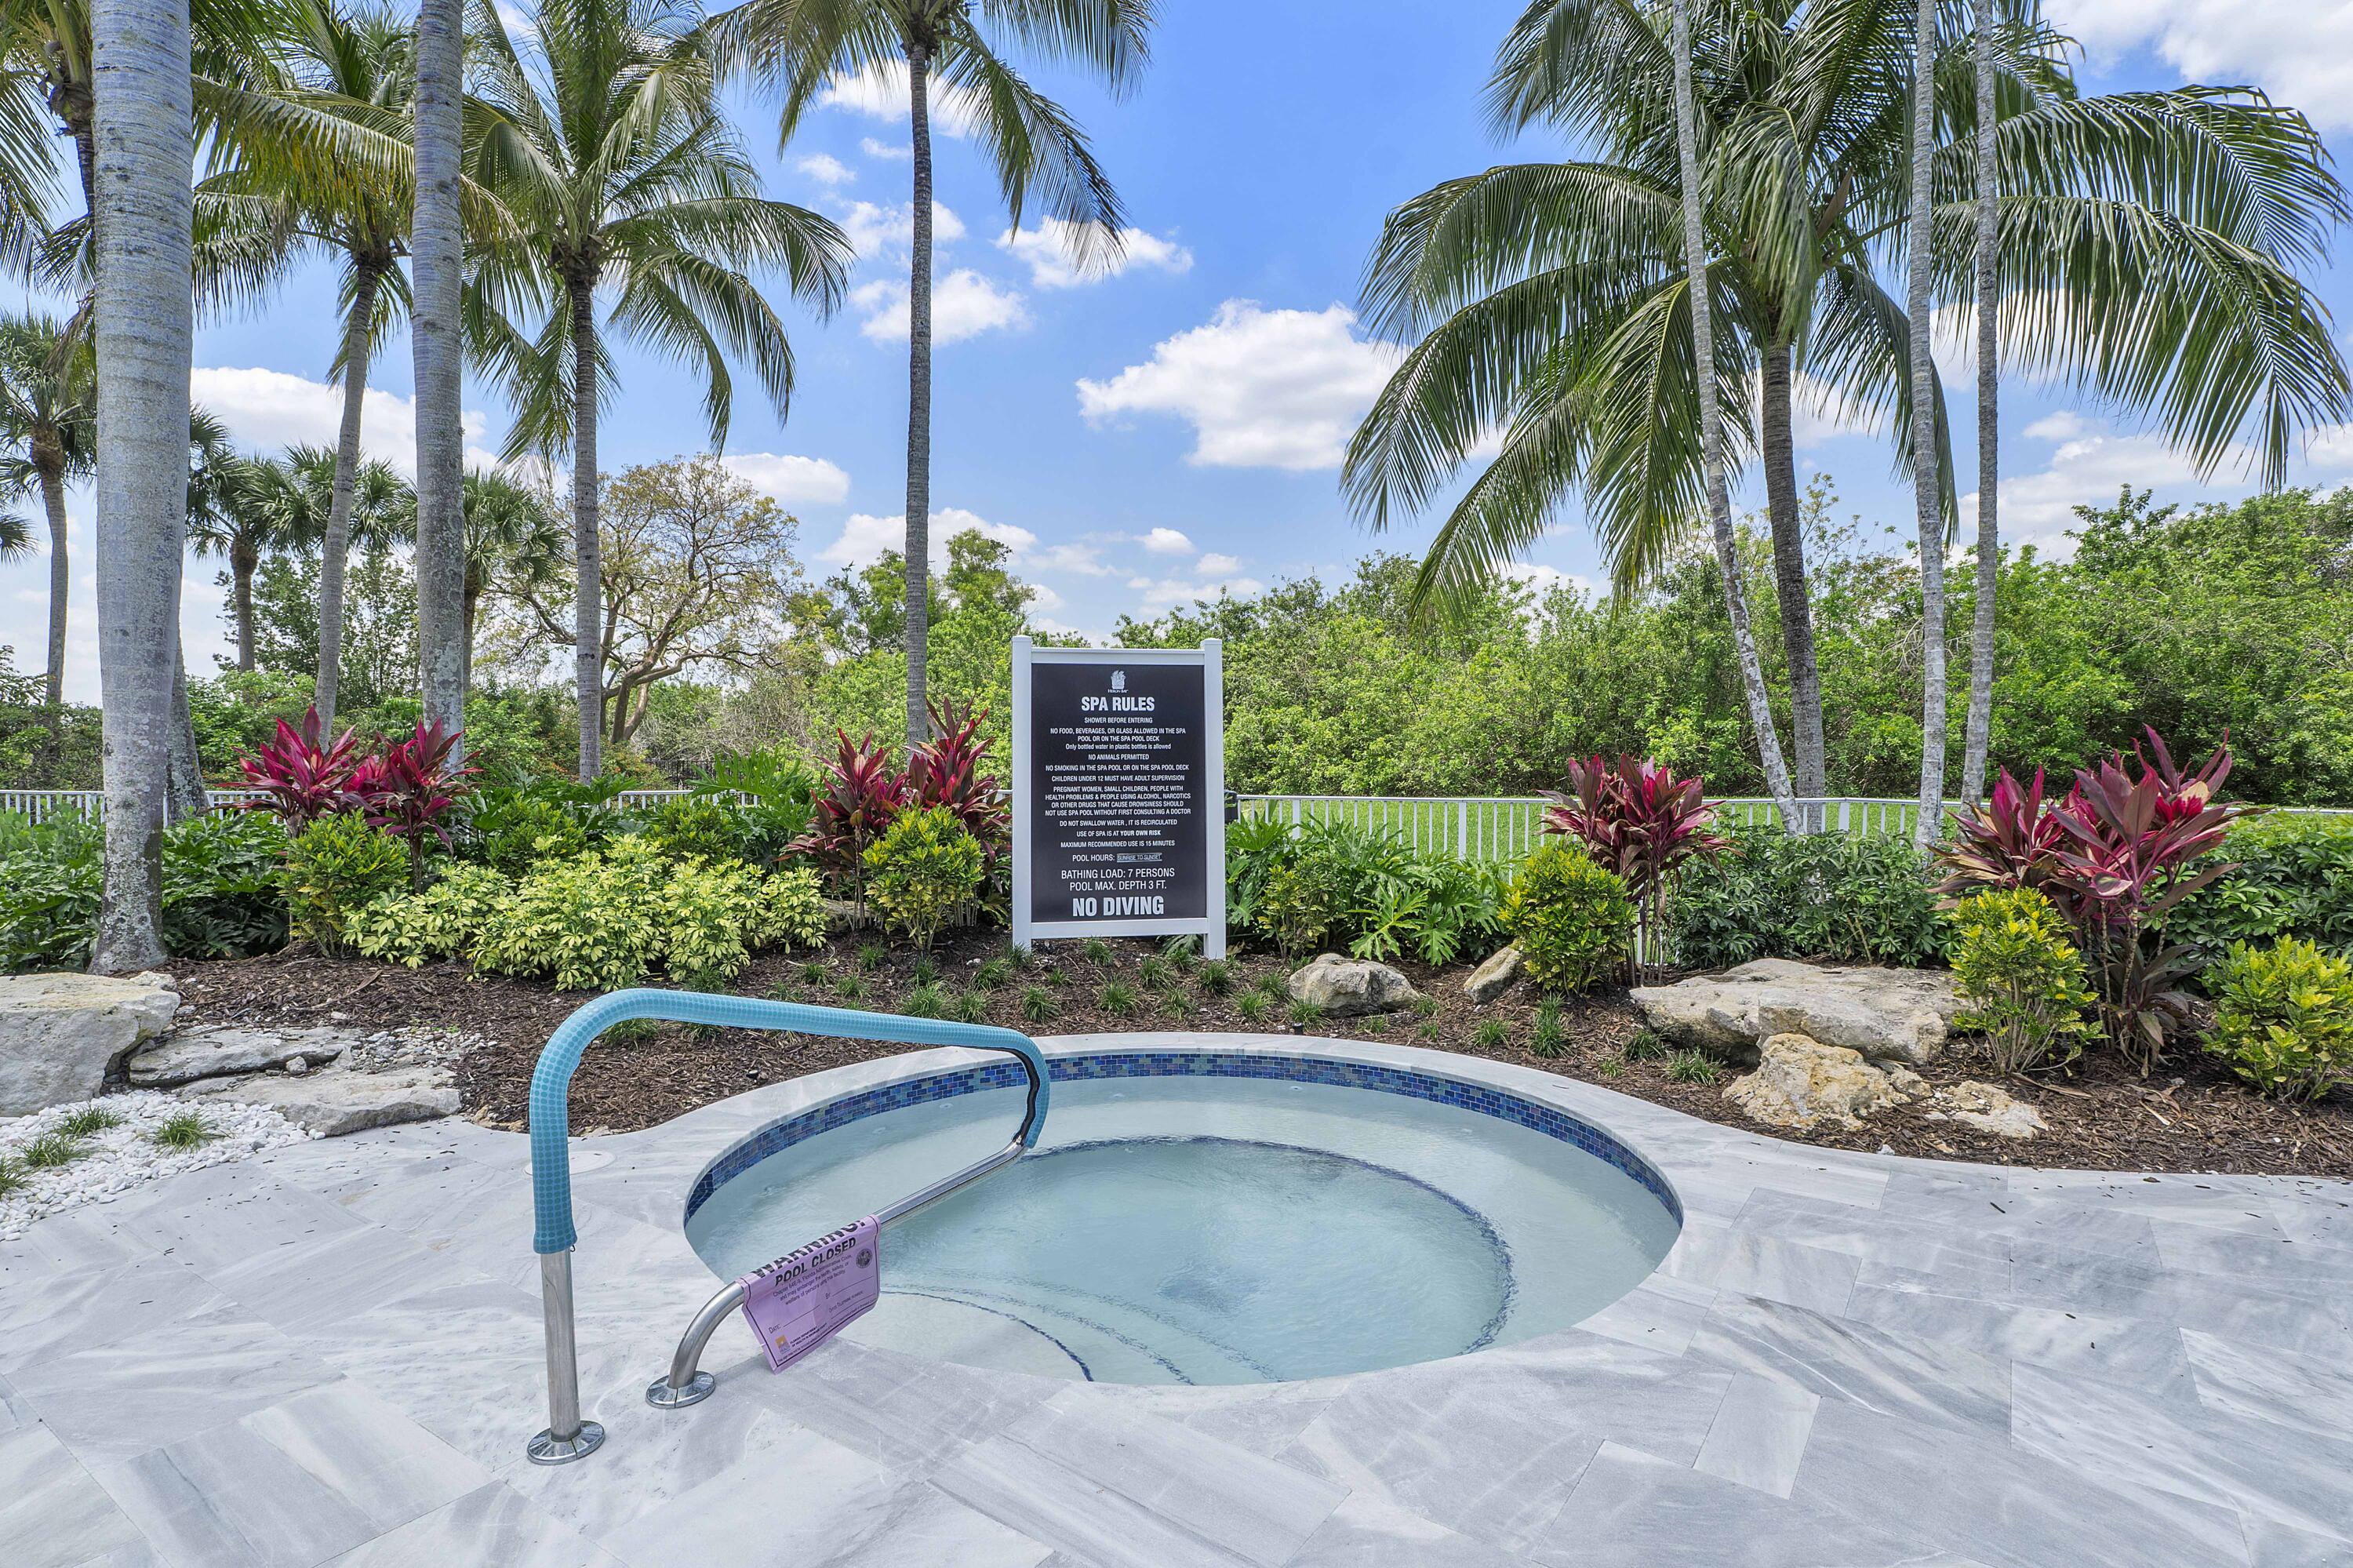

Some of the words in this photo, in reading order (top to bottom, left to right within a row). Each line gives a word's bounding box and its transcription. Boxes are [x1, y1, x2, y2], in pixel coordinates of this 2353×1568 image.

[1082, 697, 1108, 711] SPA
[1113, 697, 1155, 711] RULES
[1061, 870, 1097, 879] BATHING
[1100, 869, 1126, 878] LOAD:
[1136, 868, 1175, 878] PERSONS
[1070, 882, 1093, 891] POOL
[1095, 882, 1116, 890] MAX.
[1119, 881, 1146, 890] DEPTH
[1148, 880, 1153, 890] 3
[1156, 880, 1166, 889] FT.
[1073, 897, 1096, 916] NO
[1104, 896, 1164, 915] DIVING
[775, 1263, 808, 1286] POOL
[812, 1238, 856, 1268] CLOSED
[802, 1271, 816, 1282] Florida
[787, 1288, 797, 1300] may
[797, 1279, 815, 1292] endanger
